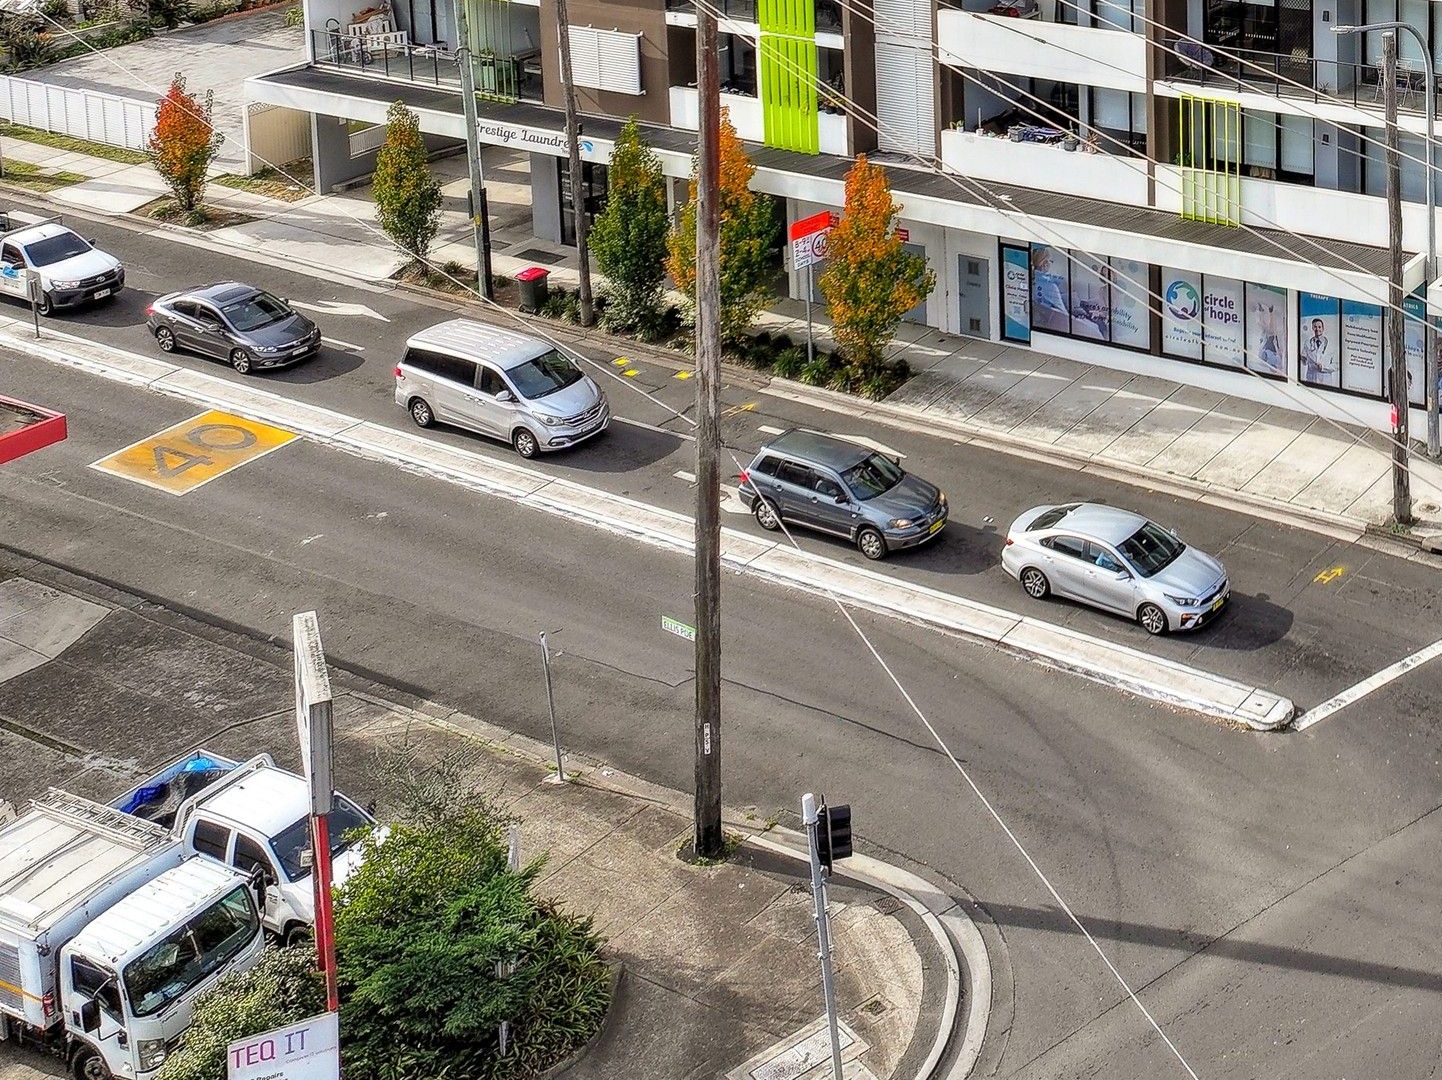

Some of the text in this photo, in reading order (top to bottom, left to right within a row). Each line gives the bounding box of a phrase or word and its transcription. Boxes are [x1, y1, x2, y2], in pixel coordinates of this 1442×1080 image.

[477, 123, 518, 143] restige
[1204, 293, 1235, 310] circle
[154, 423, 258, 479] 40
[231, 1028, 310, 1068] TEQ IT
